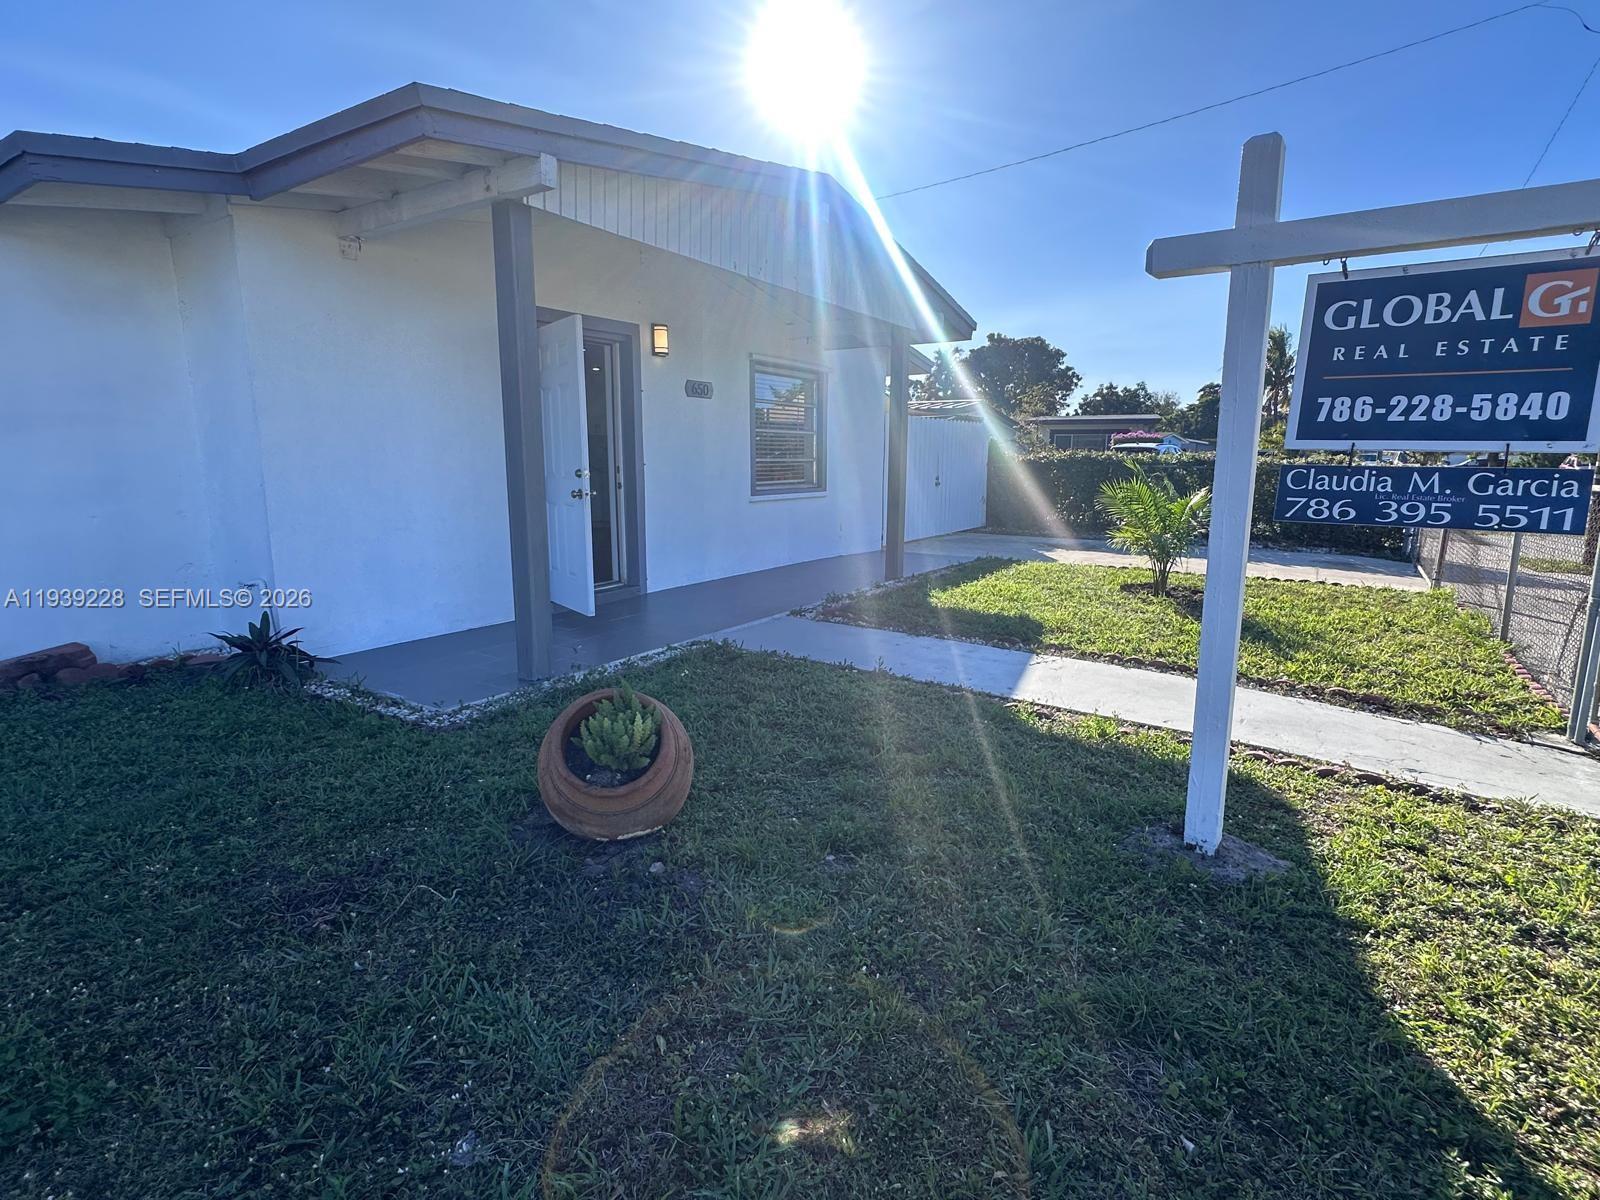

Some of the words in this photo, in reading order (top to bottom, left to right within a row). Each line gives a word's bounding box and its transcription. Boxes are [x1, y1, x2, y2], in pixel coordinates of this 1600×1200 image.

[1323, 287, 1514, 331] GLOBAL
[1332, 344, 1409, 361] REAL
[1435, 334, 1570, 356] ESTATE
[692, 382, 709, 396] 650
[1316, 391, 1571, 422] 786-228-5840
[1286, 468, 1393, 493] Claudia
[1407, 471, 1451, 494] M.
[1467, 472, 1580, 498] Garcia
[1437, 494, 1465, 503] Broker
[1284, 497, 1357, 520] 786
[1375, 500, 1452, 525] 395
[1474, 503, 1575, 531] 5511
